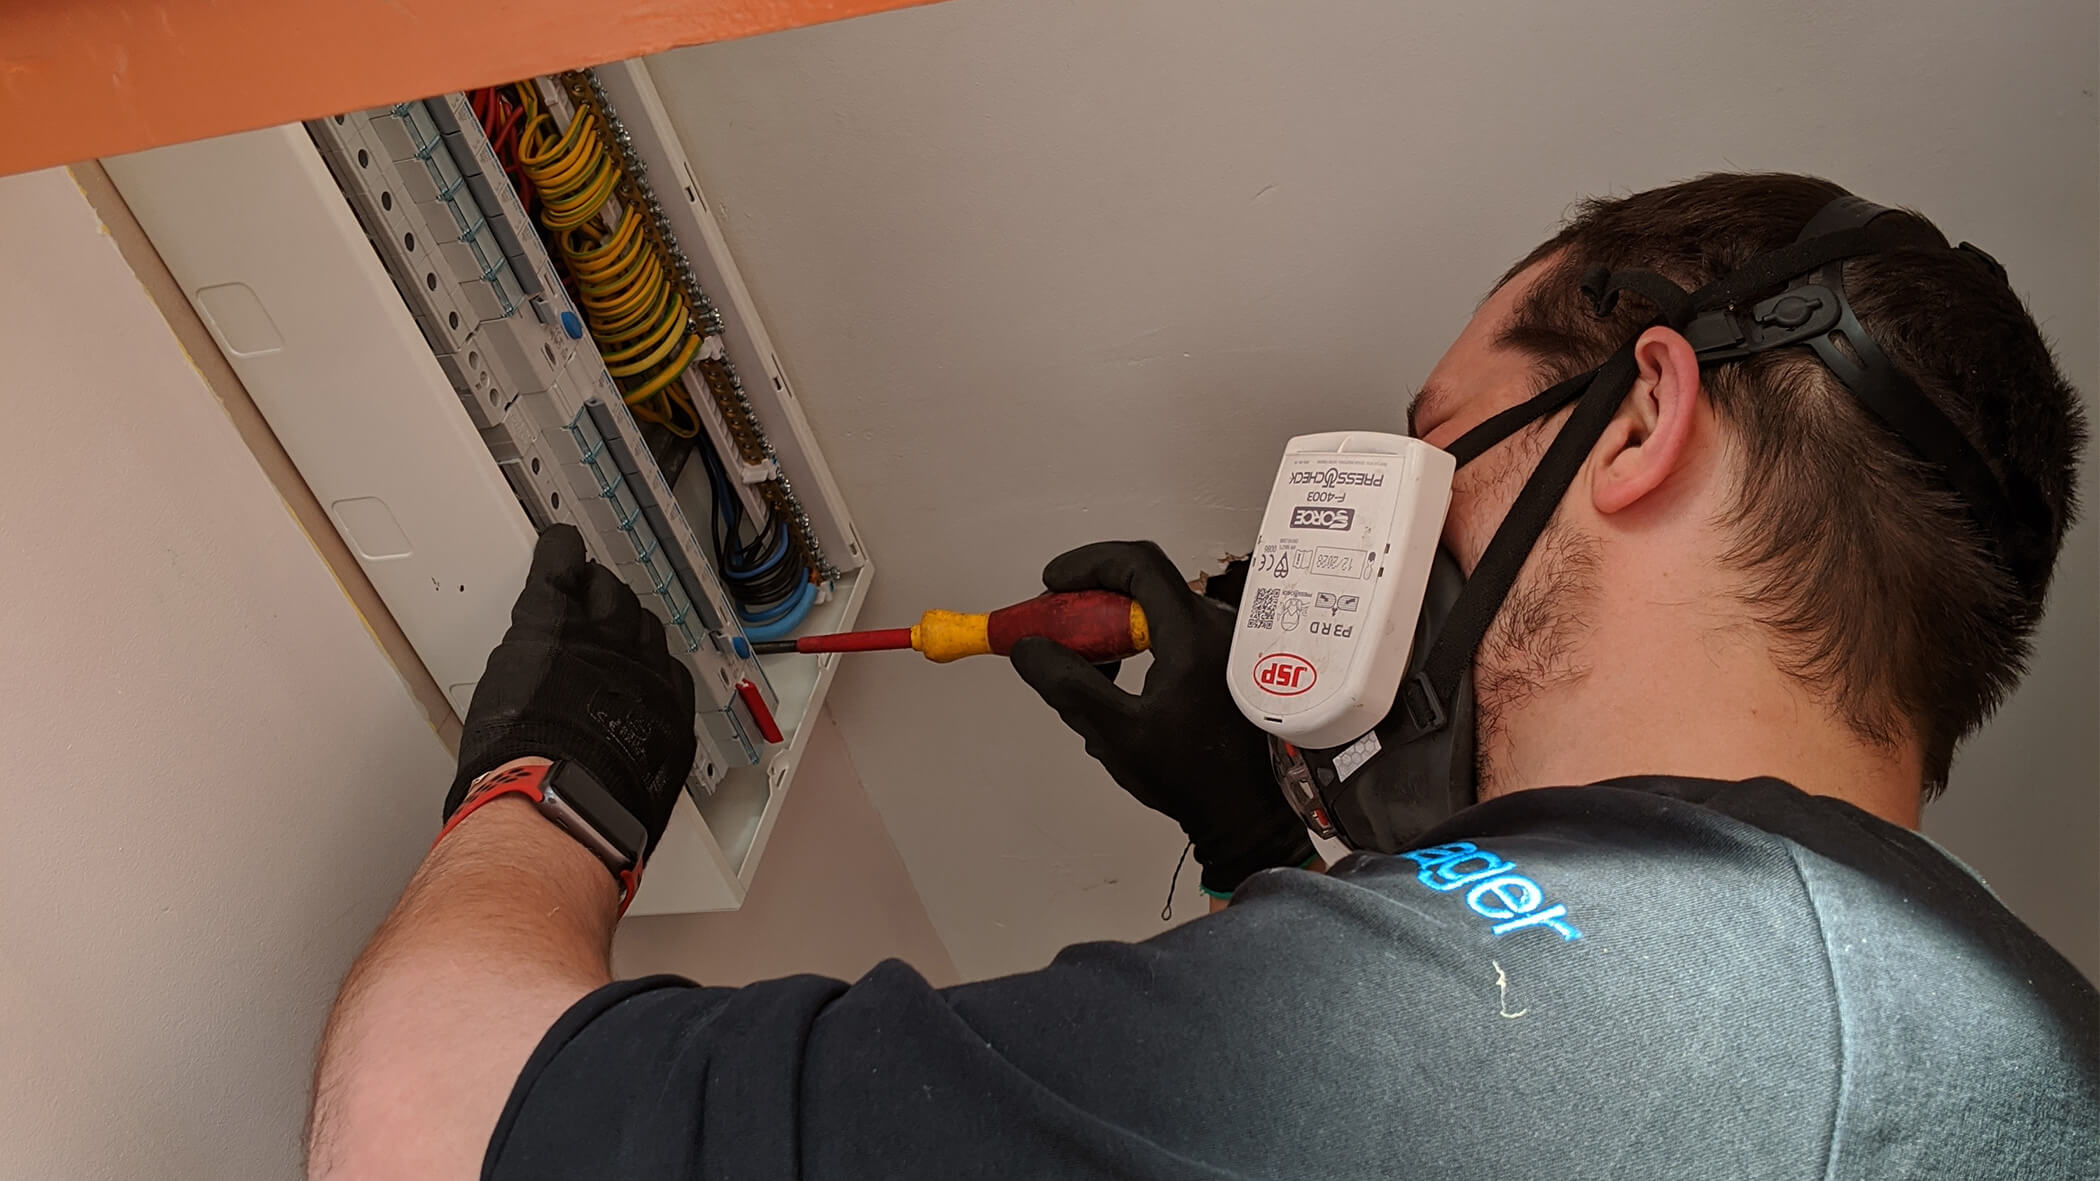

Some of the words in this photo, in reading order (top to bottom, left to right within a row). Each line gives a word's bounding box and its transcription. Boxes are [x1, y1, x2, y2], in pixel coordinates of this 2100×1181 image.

[1306, 491, 1346, 503] F-4003
[1333, 623, 1353, 638] P3
[1261, 662, 1308, 688] JSP
